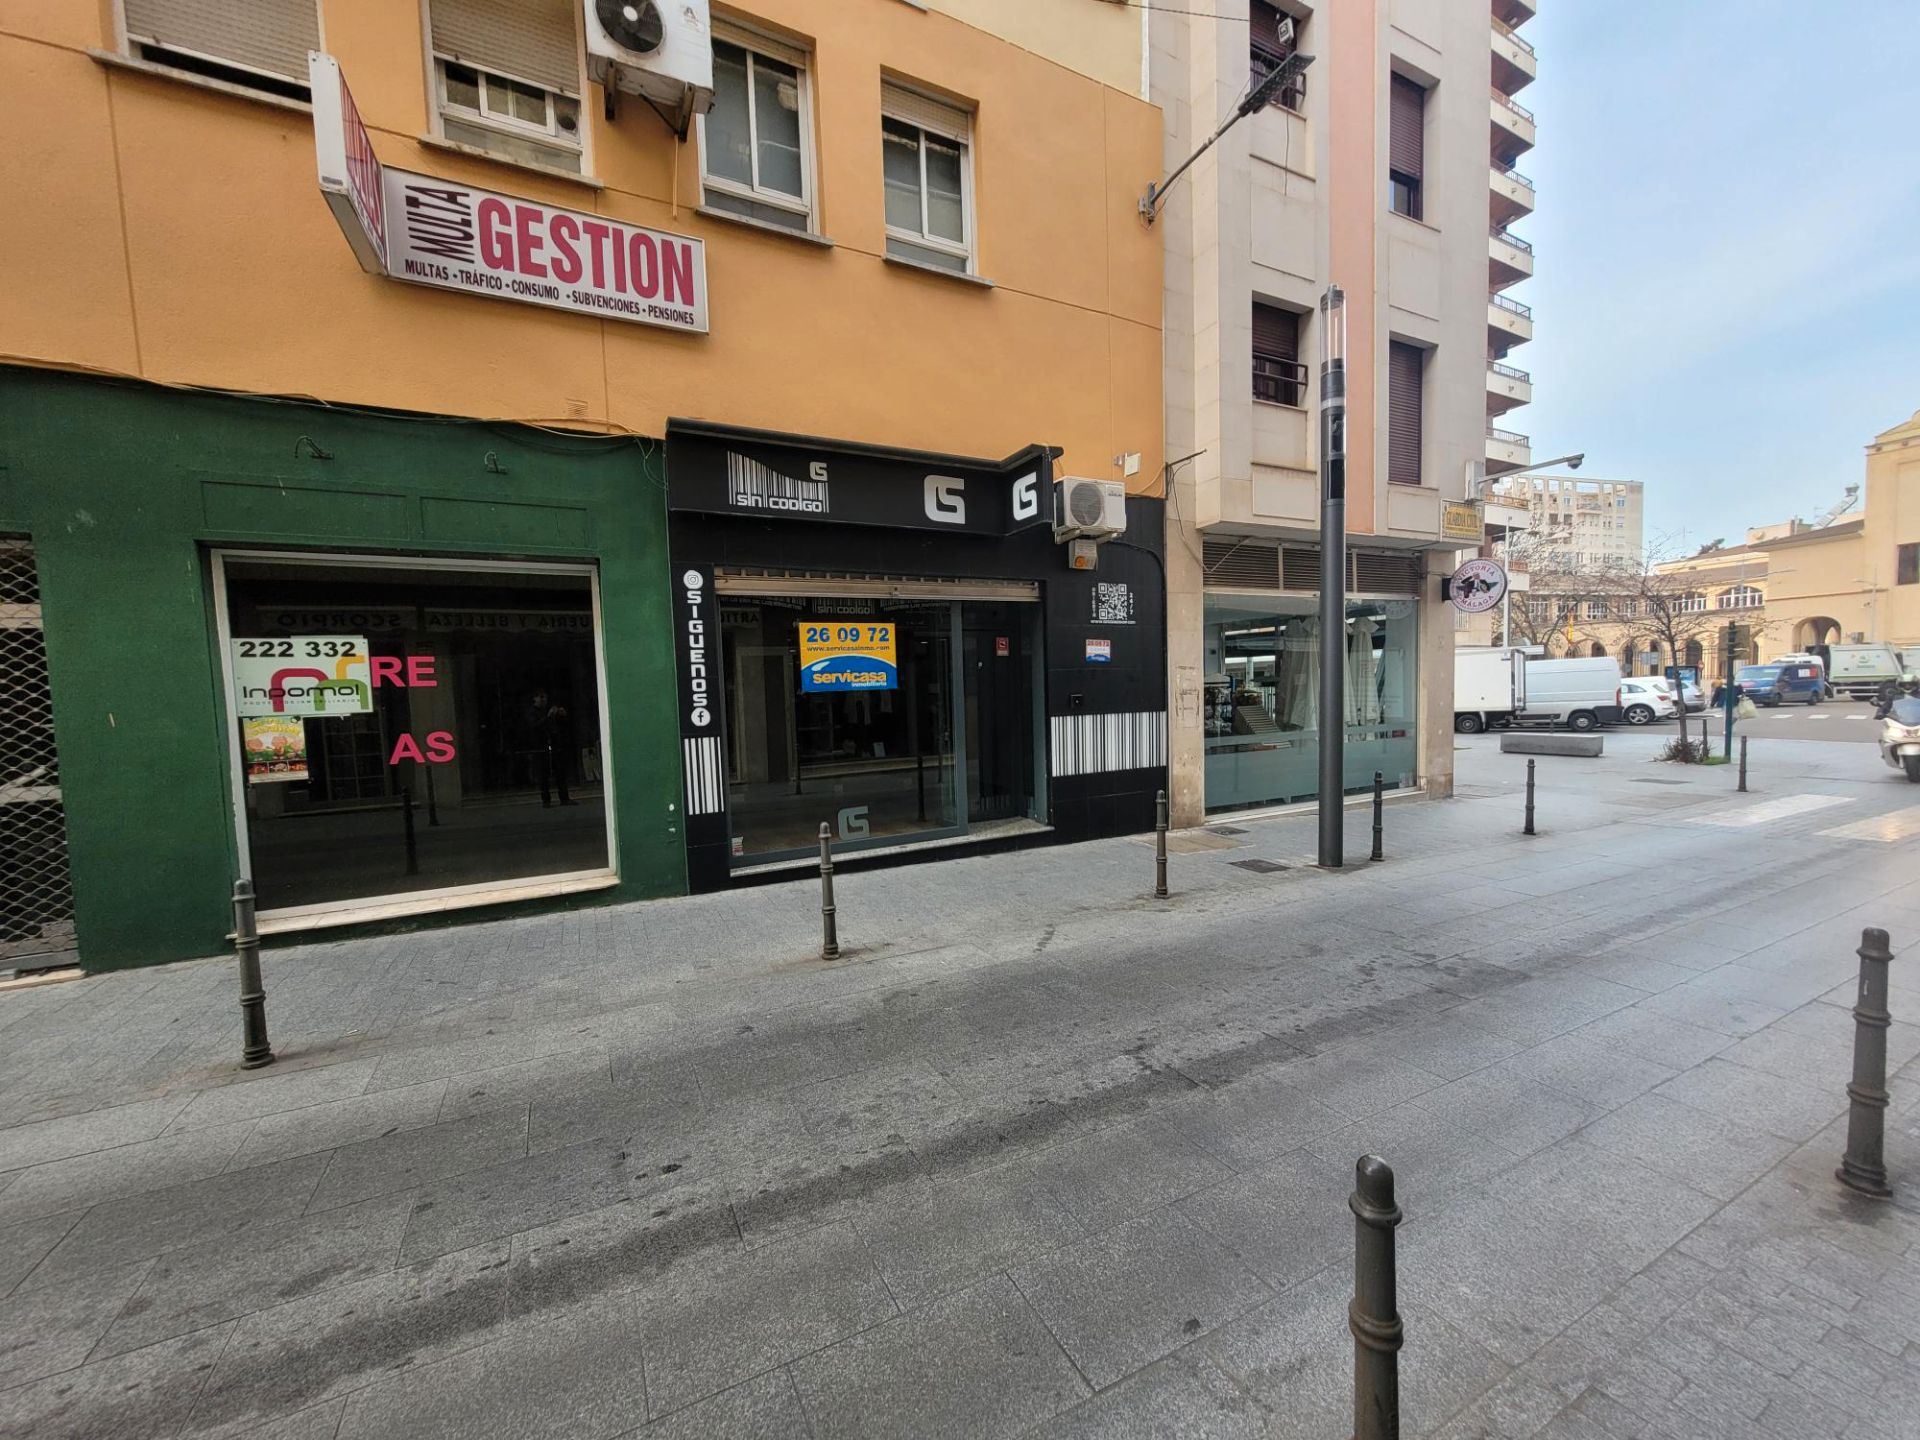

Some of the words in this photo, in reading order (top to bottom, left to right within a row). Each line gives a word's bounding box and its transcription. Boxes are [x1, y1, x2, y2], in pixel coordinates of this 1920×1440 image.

[405, 184, 475, 264] MULTA
[478, 198, 695, 307] GESTION
[404, 258, 449, 280] MULTAS
[458, 269, 503, 291] TRÁFICO
[511, 279, 560, 300] CONSUMO
[572, 290, 640, 315] SUBVENCIONES
[648, 304, 695, 325] PENSIONES
[1457, 564, 1496, 581] VICTORIA
[806, 627, 831, 643] 26
[837, 627, 860, 643] 09
[867, 627, 890, 642] 72
[240, 641, 295, 658] 222
[305, 641, 357, 658] 332
[812, 669, 887, 684] servicasa
[389, 730, 457, 765] AS
